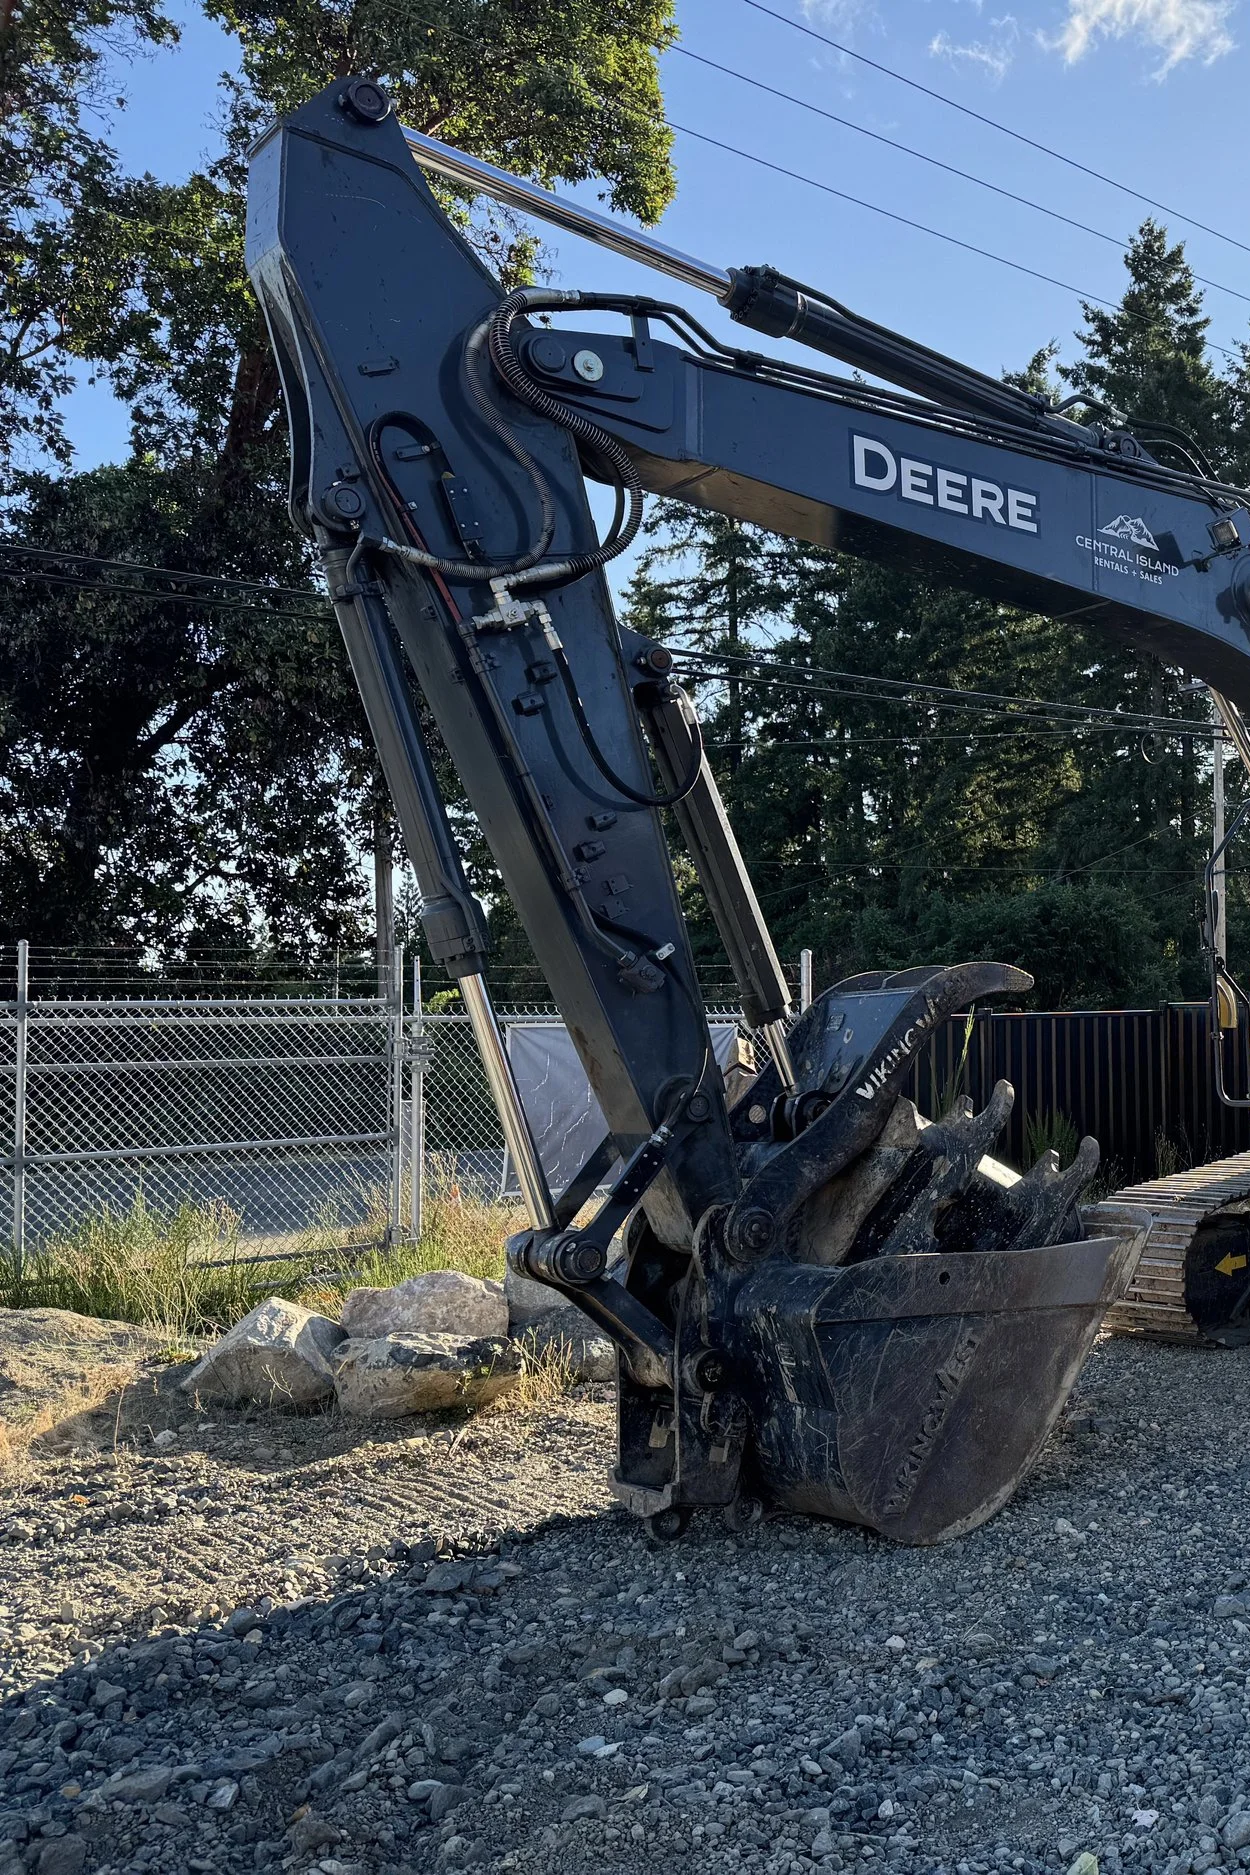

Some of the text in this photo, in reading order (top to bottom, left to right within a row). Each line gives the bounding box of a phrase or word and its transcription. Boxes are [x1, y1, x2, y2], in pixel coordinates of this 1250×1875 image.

[853, 435, 1038, 533] DEERE
[1075, 535, 1179, 577] CENTRAL ISLAND
[1094, 556, 1129, 574] RENTALS
[1139, 570, 1163, 585] SALES
